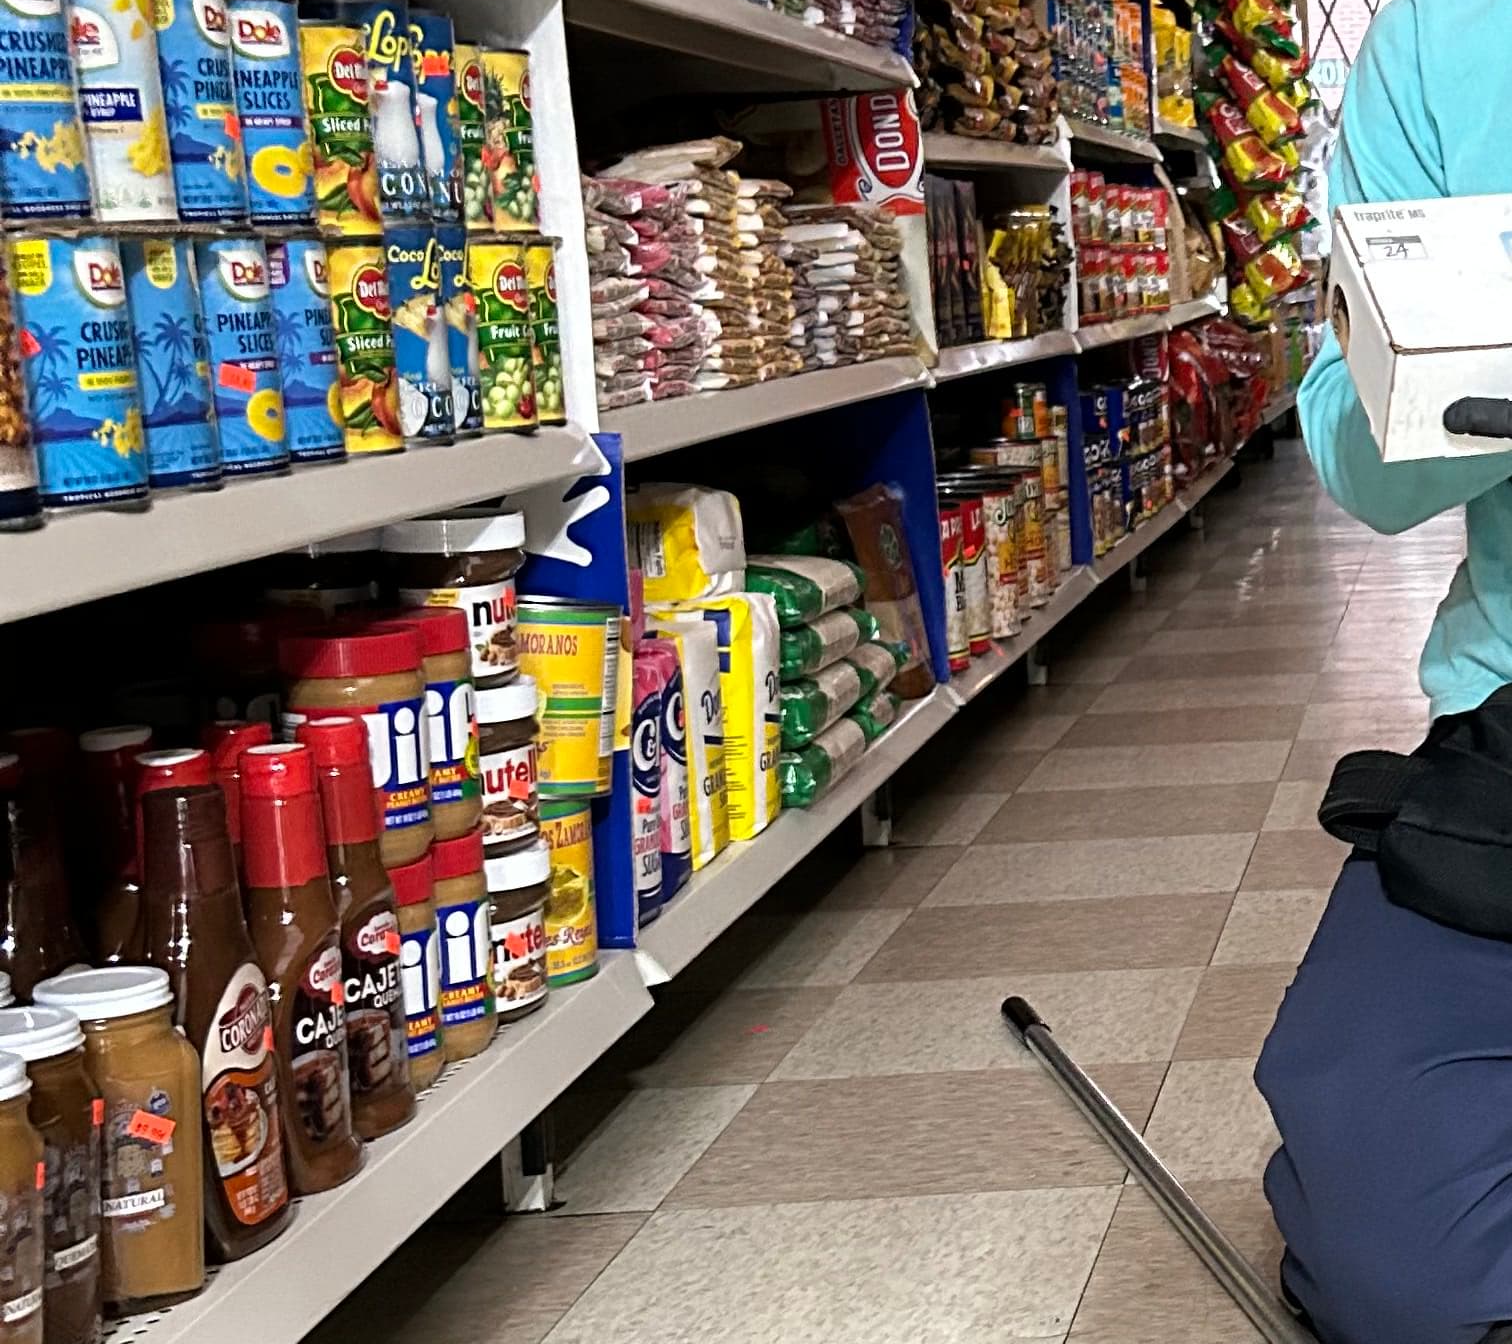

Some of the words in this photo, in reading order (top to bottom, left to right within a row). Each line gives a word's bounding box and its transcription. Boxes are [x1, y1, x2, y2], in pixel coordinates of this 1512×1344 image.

[204, 5, 226, 27] Do
[238, 19, 282, 42] Dole
[368, 9, 409, 73] Lop
[197, 56, 230, 78] CRUS
[234, 69, 298, 92] INEAPPLE
[243, 91, 291, 111] SLICES
[322, 117, 362, 133] Sliced
[1354, 208, 1404, 223] traprite
[388, 245, 423, 263] Coco
[1383, 243, 1410, 260] 24
[491, 324, 521, 340] Fruit
[347, 334, 385, 353] Sliced
[427, 685, 475, 762] if
[444, 902, 491, 985] if
[401, 928, 440, 1016] if
[104, 1190, 164, 1214] NATURAL
